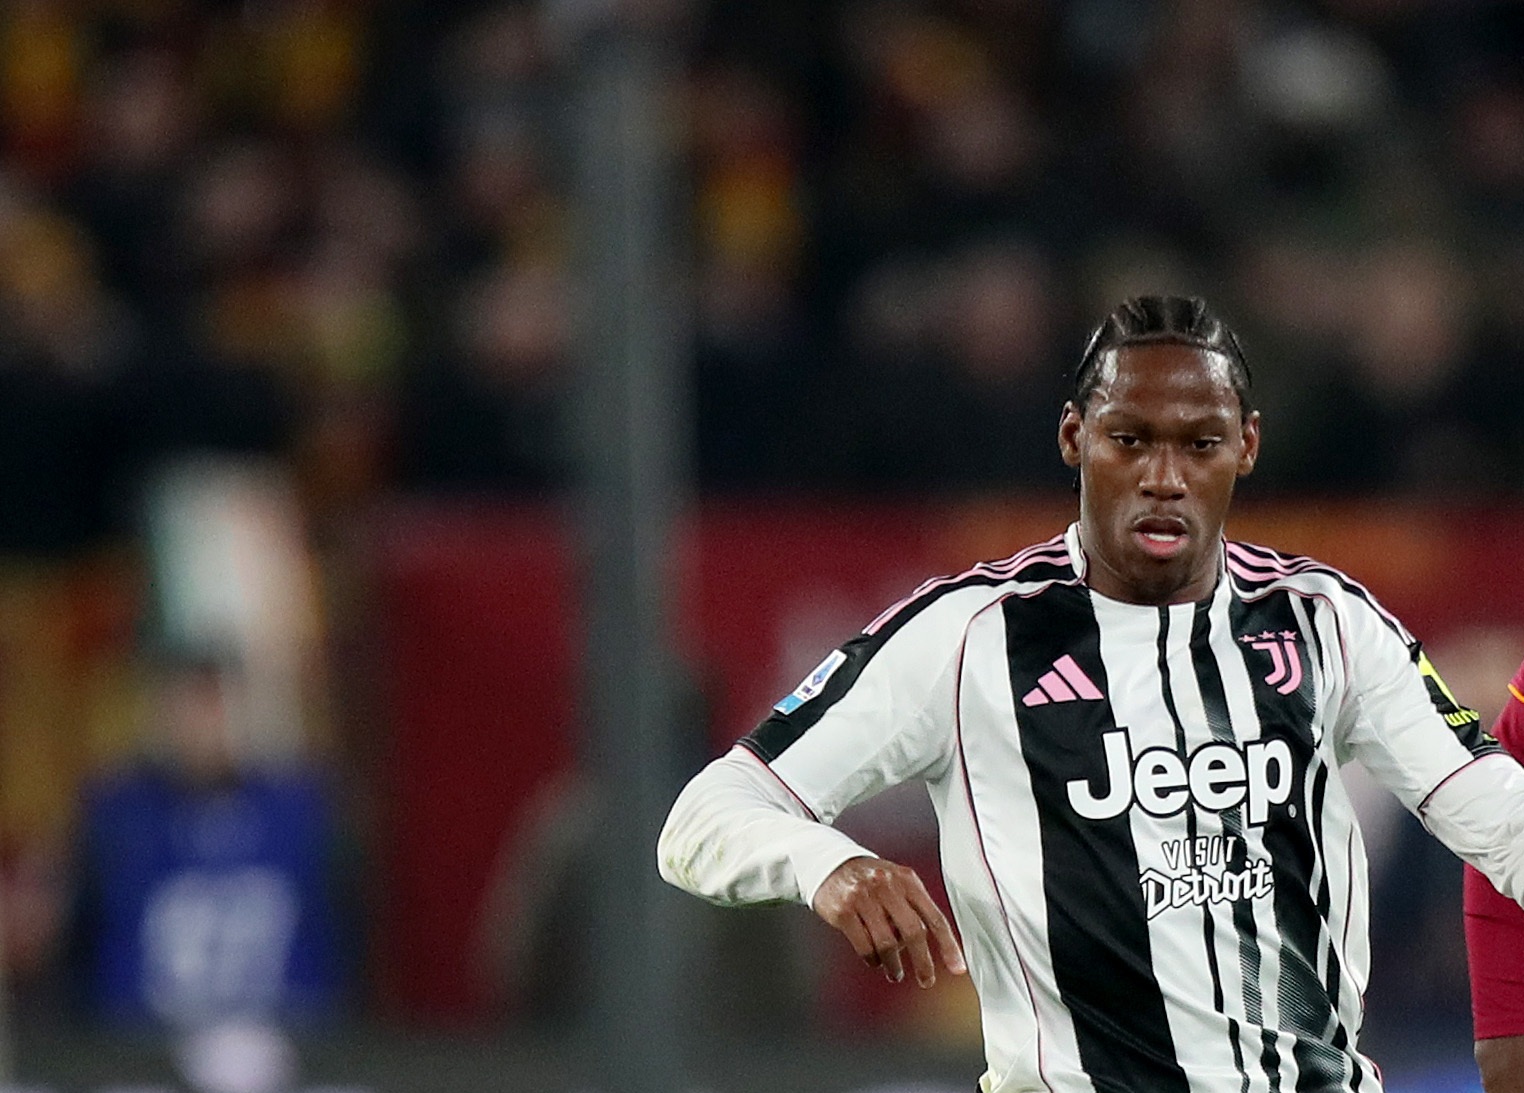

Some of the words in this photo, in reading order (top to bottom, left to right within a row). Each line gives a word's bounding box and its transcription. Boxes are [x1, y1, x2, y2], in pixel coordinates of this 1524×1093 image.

[1065, 729, 1293, 824] Jeep
[1161, 835, 1238, 870] VISIT
[1138, 858, 1274, 921] Detroit
